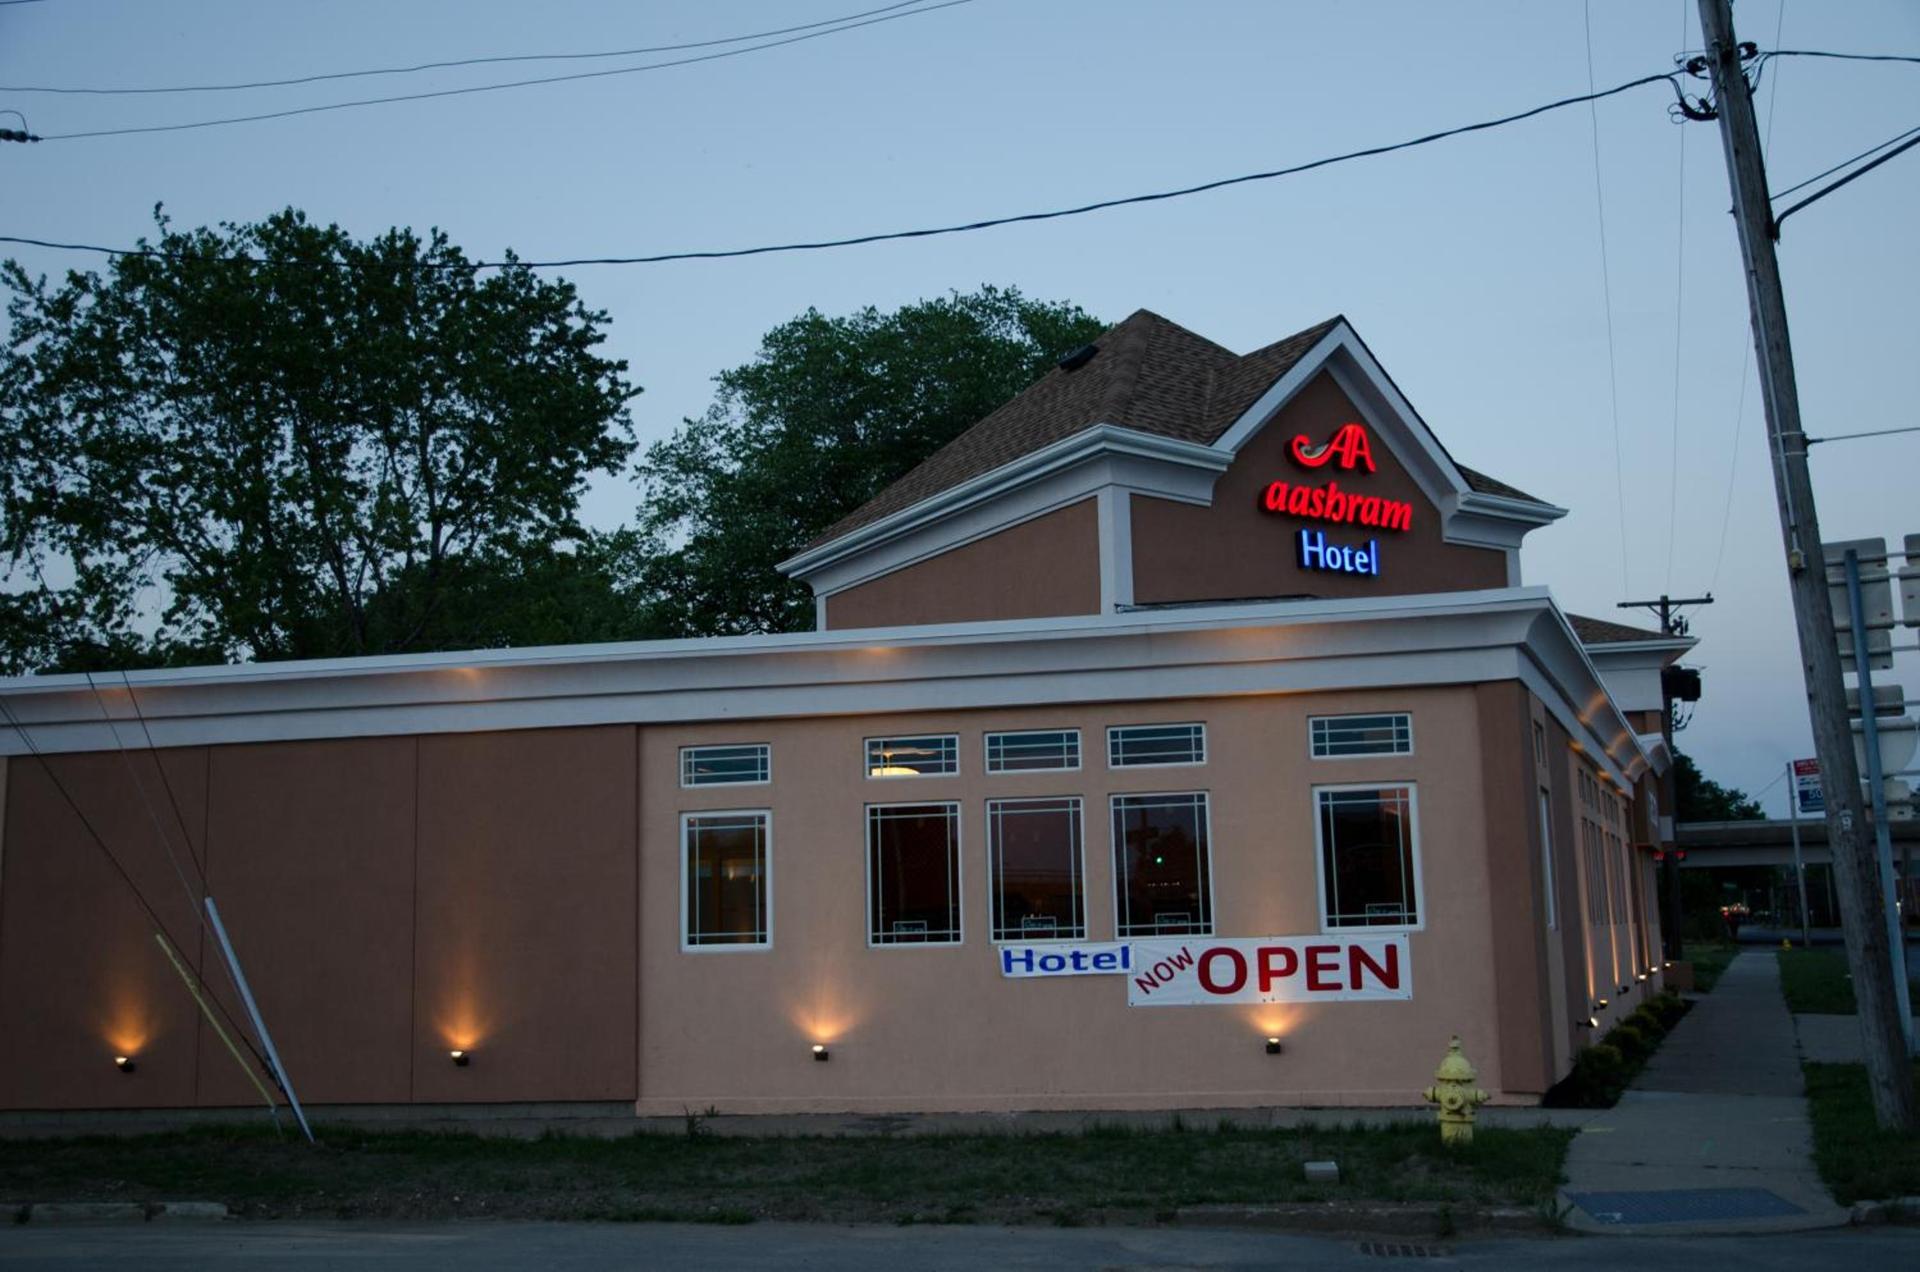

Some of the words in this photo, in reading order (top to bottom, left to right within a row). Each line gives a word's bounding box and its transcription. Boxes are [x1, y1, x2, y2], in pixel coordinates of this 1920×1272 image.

[1265, 480, 1413, 531] aashram
[1302, 529, 1378, 575] Hotel
[1003, 946, 1130, 974] Hotel
[1134, 946, 1195, 995] NOW
[1198, 943, 1400, 995] OPEN
